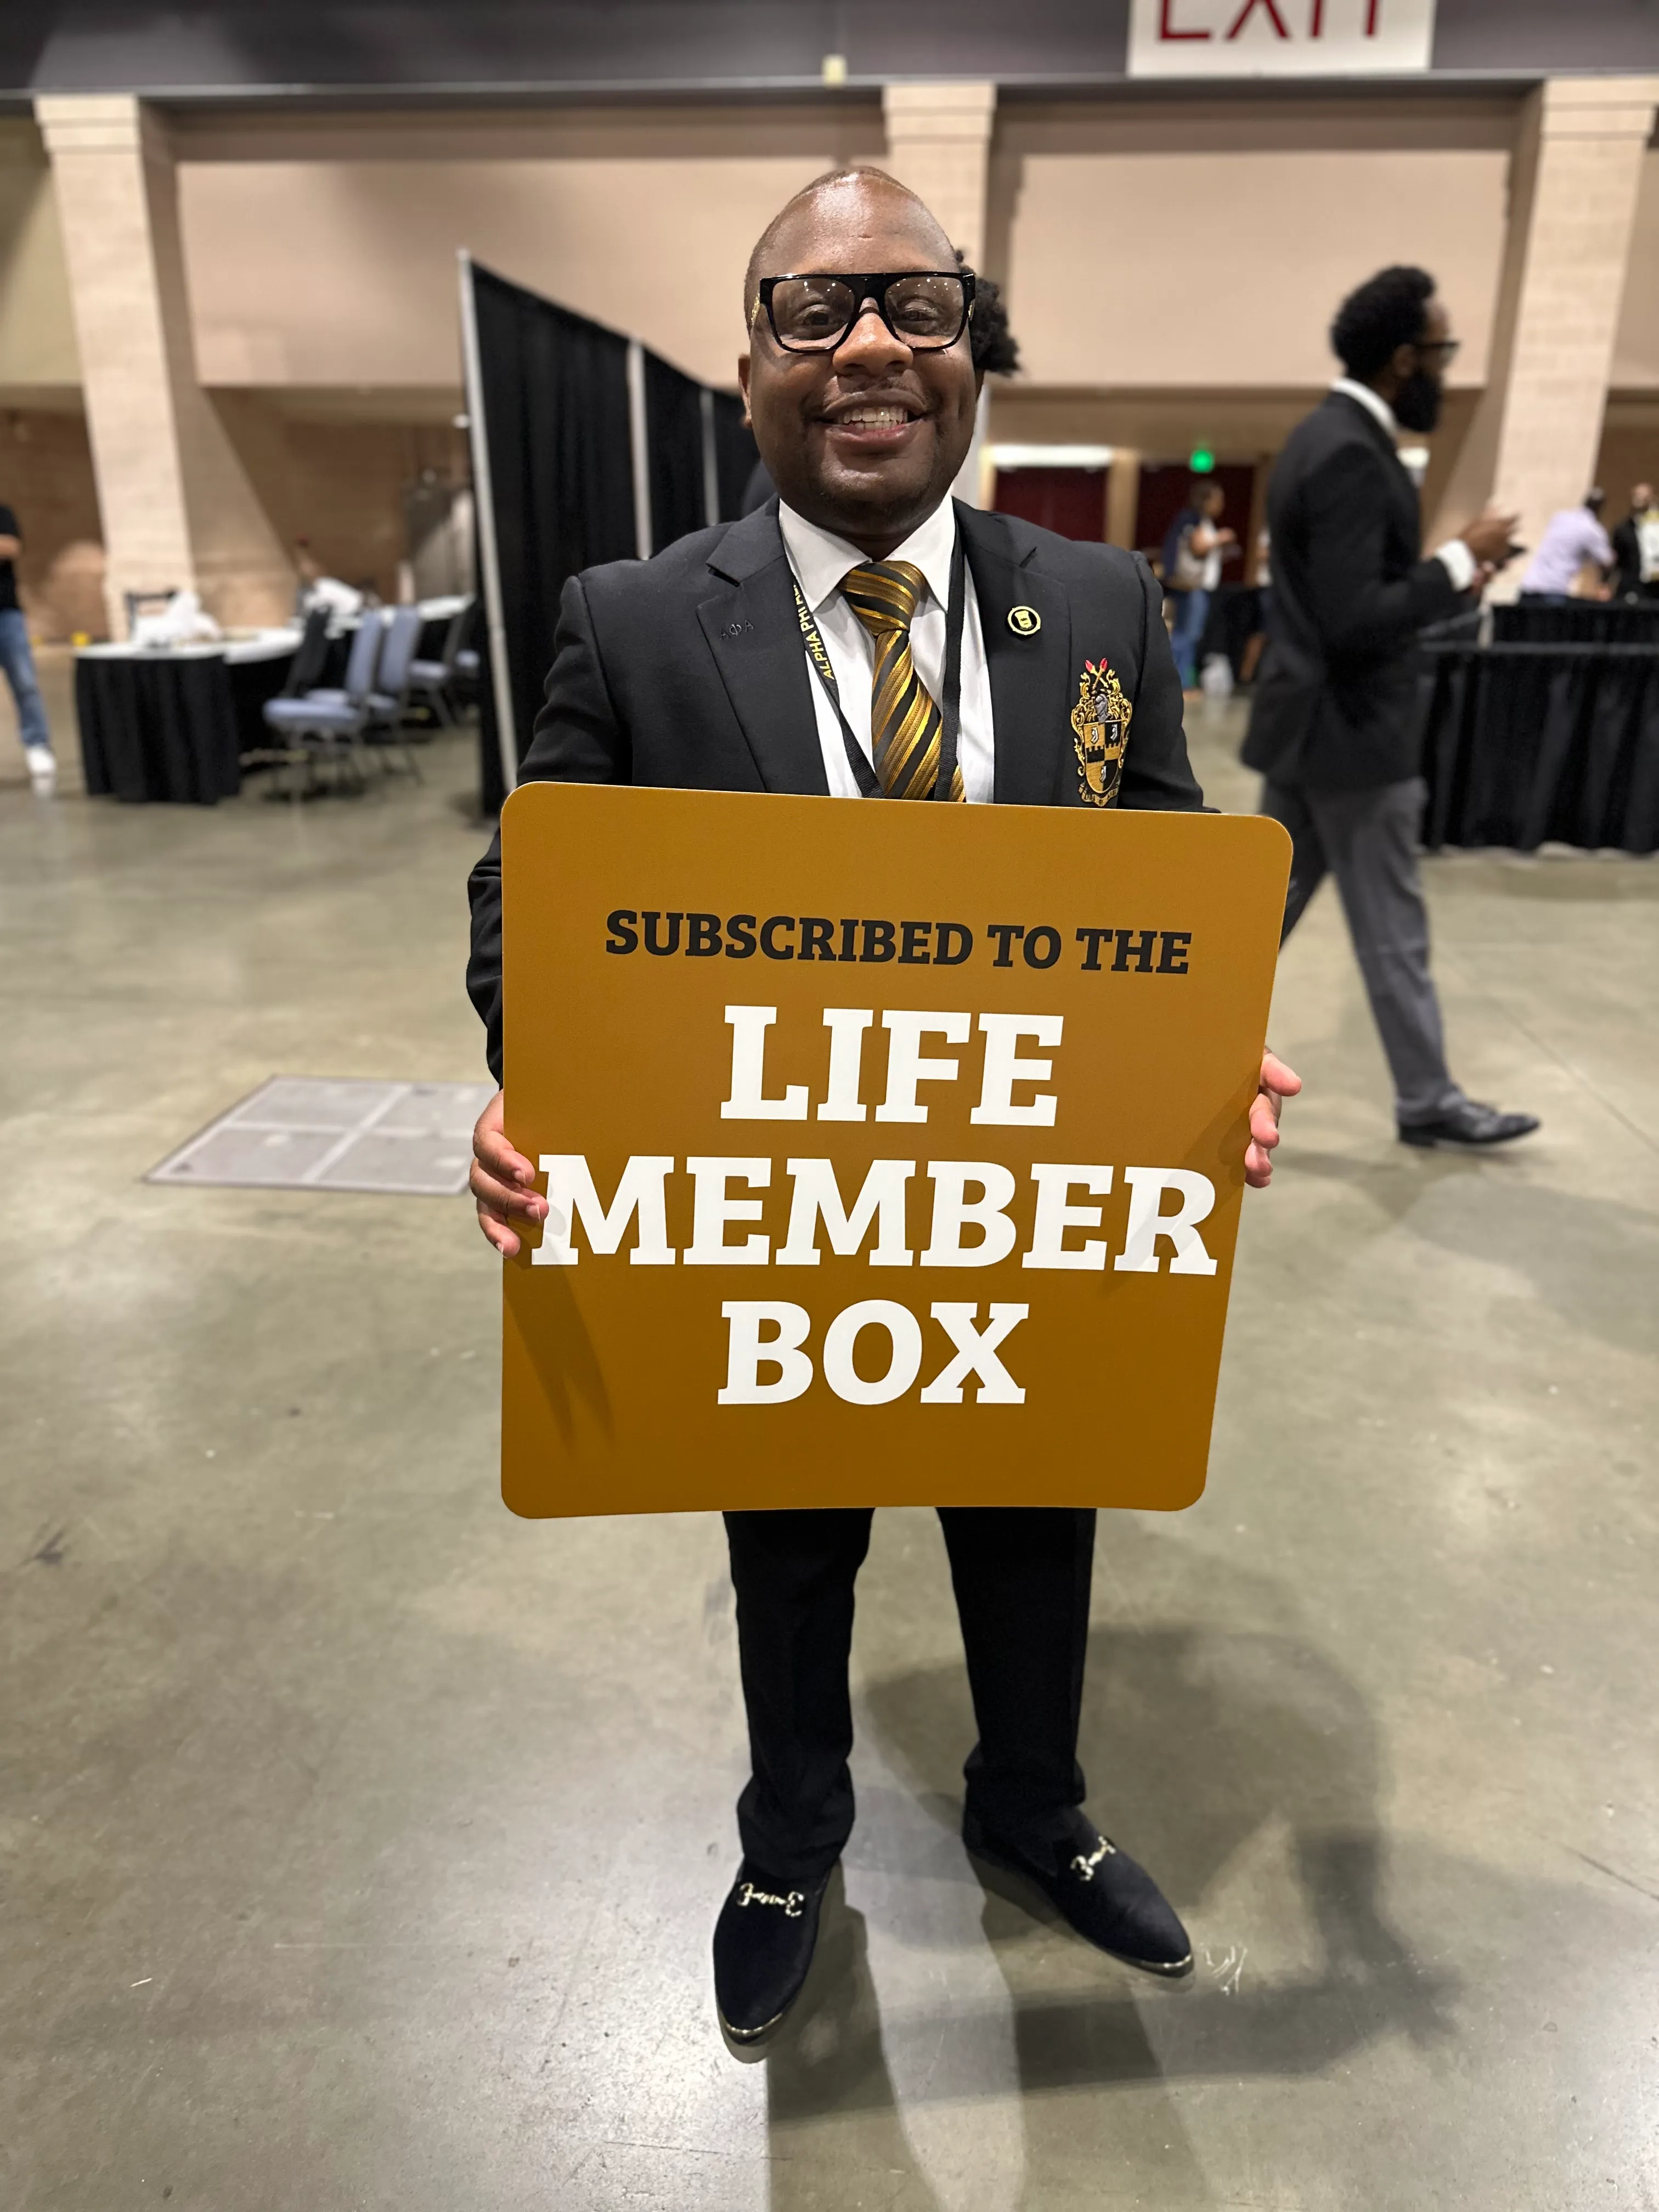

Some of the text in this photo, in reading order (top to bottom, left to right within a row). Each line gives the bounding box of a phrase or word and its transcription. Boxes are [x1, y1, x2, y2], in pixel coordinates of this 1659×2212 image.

[798, 606, 814, 632] PHI
[805, 630, 836, 680] ALPHA
[606, 909, 1192, 974] SUBSCRIBED TO THE
[720, 1005, 1064, 1127] LIFE
[531, 1154, 1217, 1276] MEMBER
[717, 1299, 1029, 1405] BOX
